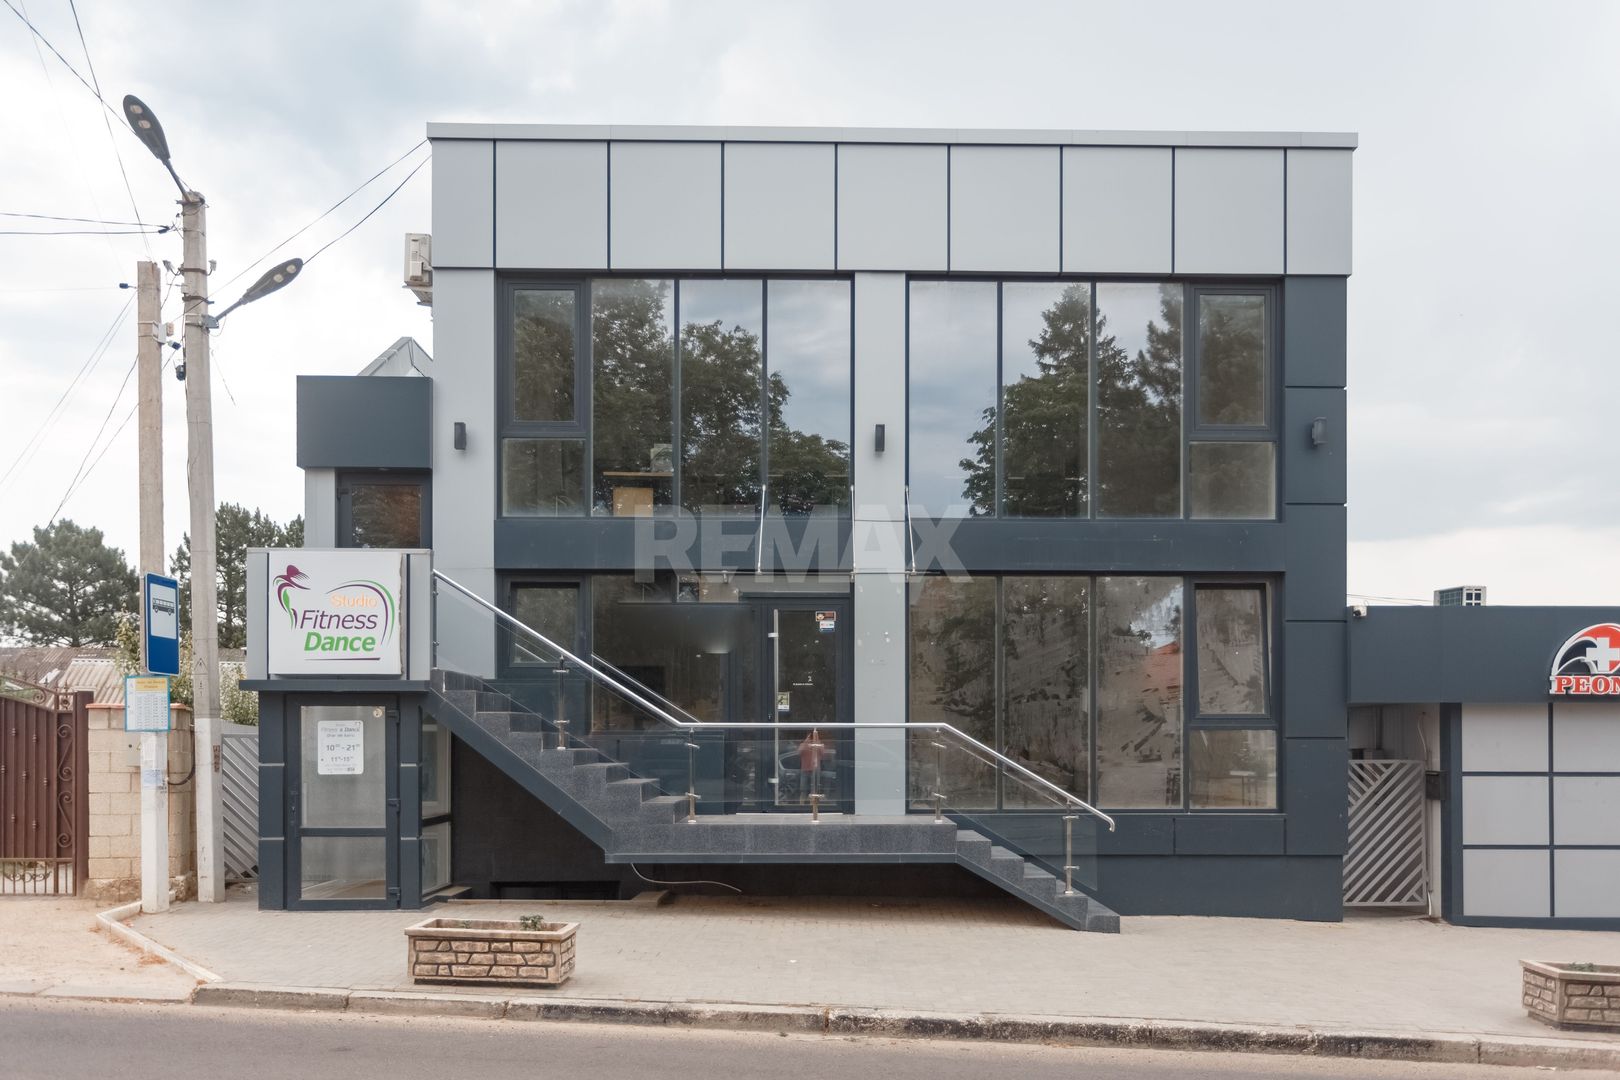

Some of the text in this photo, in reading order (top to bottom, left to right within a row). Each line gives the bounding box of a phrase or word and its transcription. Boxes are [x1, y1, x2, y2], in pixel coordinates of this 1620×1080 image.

[330, 592, 379, 608] Studio
[300, 609, 378, 630] Fitness
[304, 631, 376, 652] Dance
